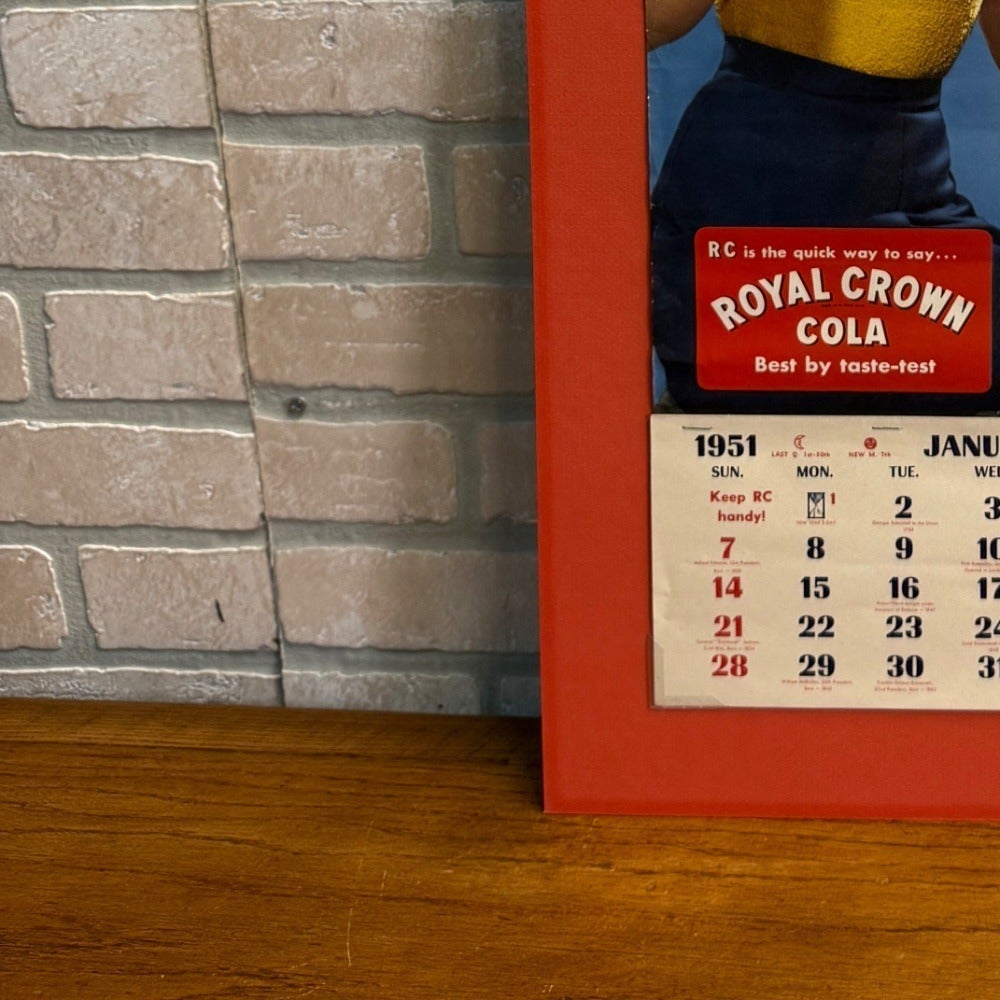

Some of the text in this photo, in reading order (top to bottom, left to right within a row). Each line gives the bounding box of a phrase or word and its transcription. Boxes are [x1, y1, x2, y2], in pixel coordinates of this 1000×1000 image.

[708, 240, 736, 258] RC
[743, 245, 756, 259] is
[761, 246, 787, 258] the
[793, 246, 836, 261] quick
[843, 250, 878, 261] way
[884, 248, 900, 259] to
[710, 266, 975, 337] ROYAL CROWN
[796, 316, 887, 345] COLA
[755, 355, 937, 376] Best by taste-test
[695, 434, 757, 457] 1951
[711, 466, 744, 478] SUN.
[796, 465, 834, 478] MON.
[889, 465, 919, 478] TUE.
[709, 490, 773, 504] Keep RC
[829, 492, 836, 505] 1
[895, 495, 912, 519] 2
[717, 510, 766, 524] handy!
[719, 537, 736, 559] 7
[806, 536, 825, 560] 8
[895, 536, 913, 560] 9
[712, 576, 744, 599] 14
[800, 576, 831, 599] 15
[889, 576, 920, 600] 16
[713, 615, 743, 638] 21
[798, 615, 835, 638] 22
[886, 615, 923, 639] 23
[711, 654, 749, 677] 28
[798, 654, 836, 677] 29
[887, 655, 924, 678] 30
